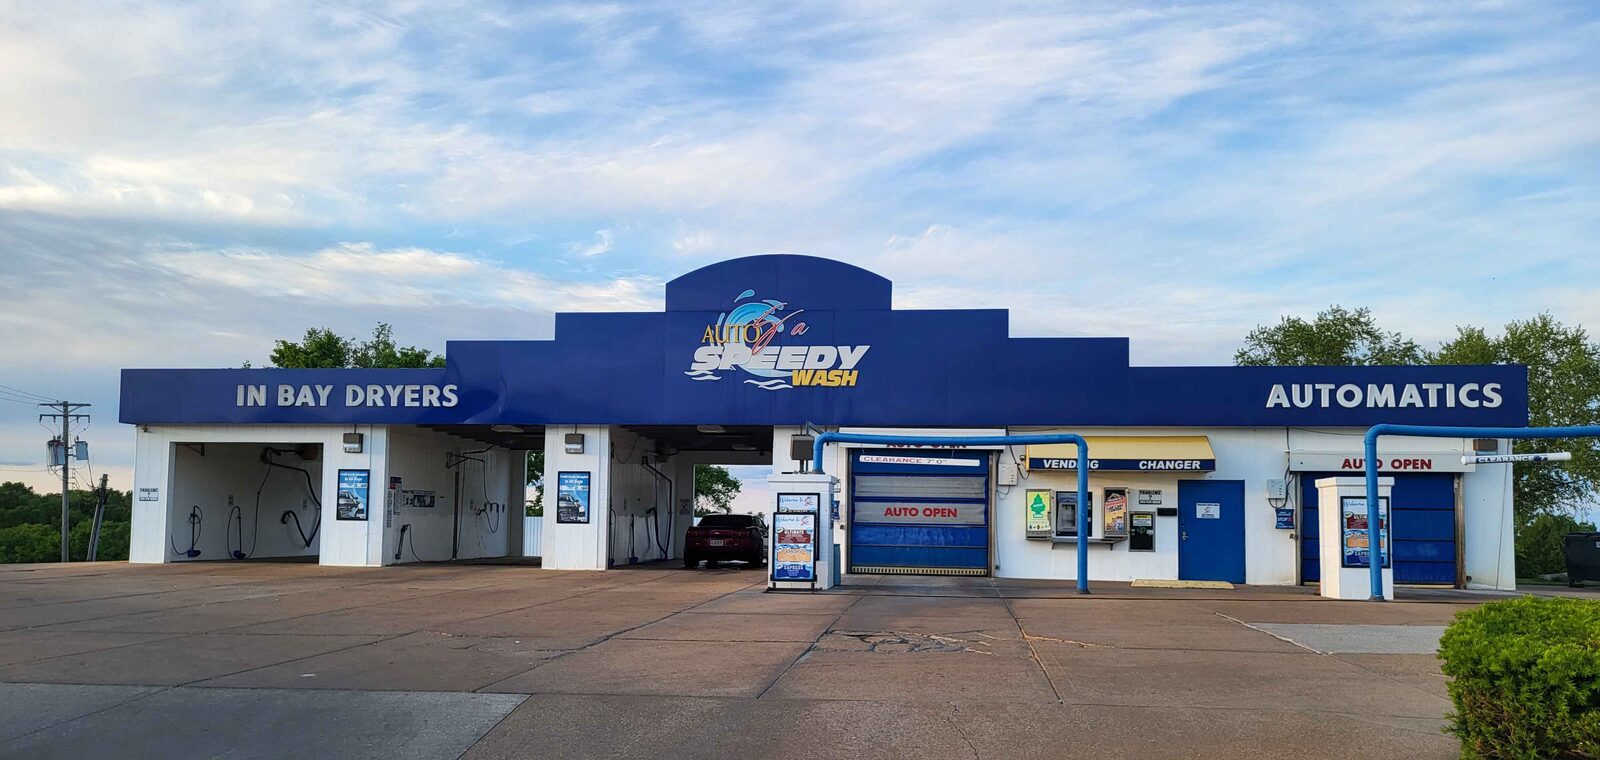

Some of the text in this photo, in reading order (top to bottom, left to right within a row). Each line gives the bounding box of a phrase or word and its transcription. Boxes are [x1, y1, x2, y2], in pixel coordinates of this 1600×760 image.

[701, 323, 760, 344] AUTO
[690, 345, 870, 371] SPEEDY
[791, 369, 859, 387] WASH
[235, 384, 459, 408] IN BAY DRYERS
[1265, 382, 1504, 409] AUTOMATICS
[863, 456, 922, 464] CLEARANCE
[1043, 459, 1099, 469] VENDG
[1138, 460, 1201, 470] CHANGER
[1341, 458, 1432, 470] AUO OPEN
[884, 507, 958, 518] AUTO OPEN
